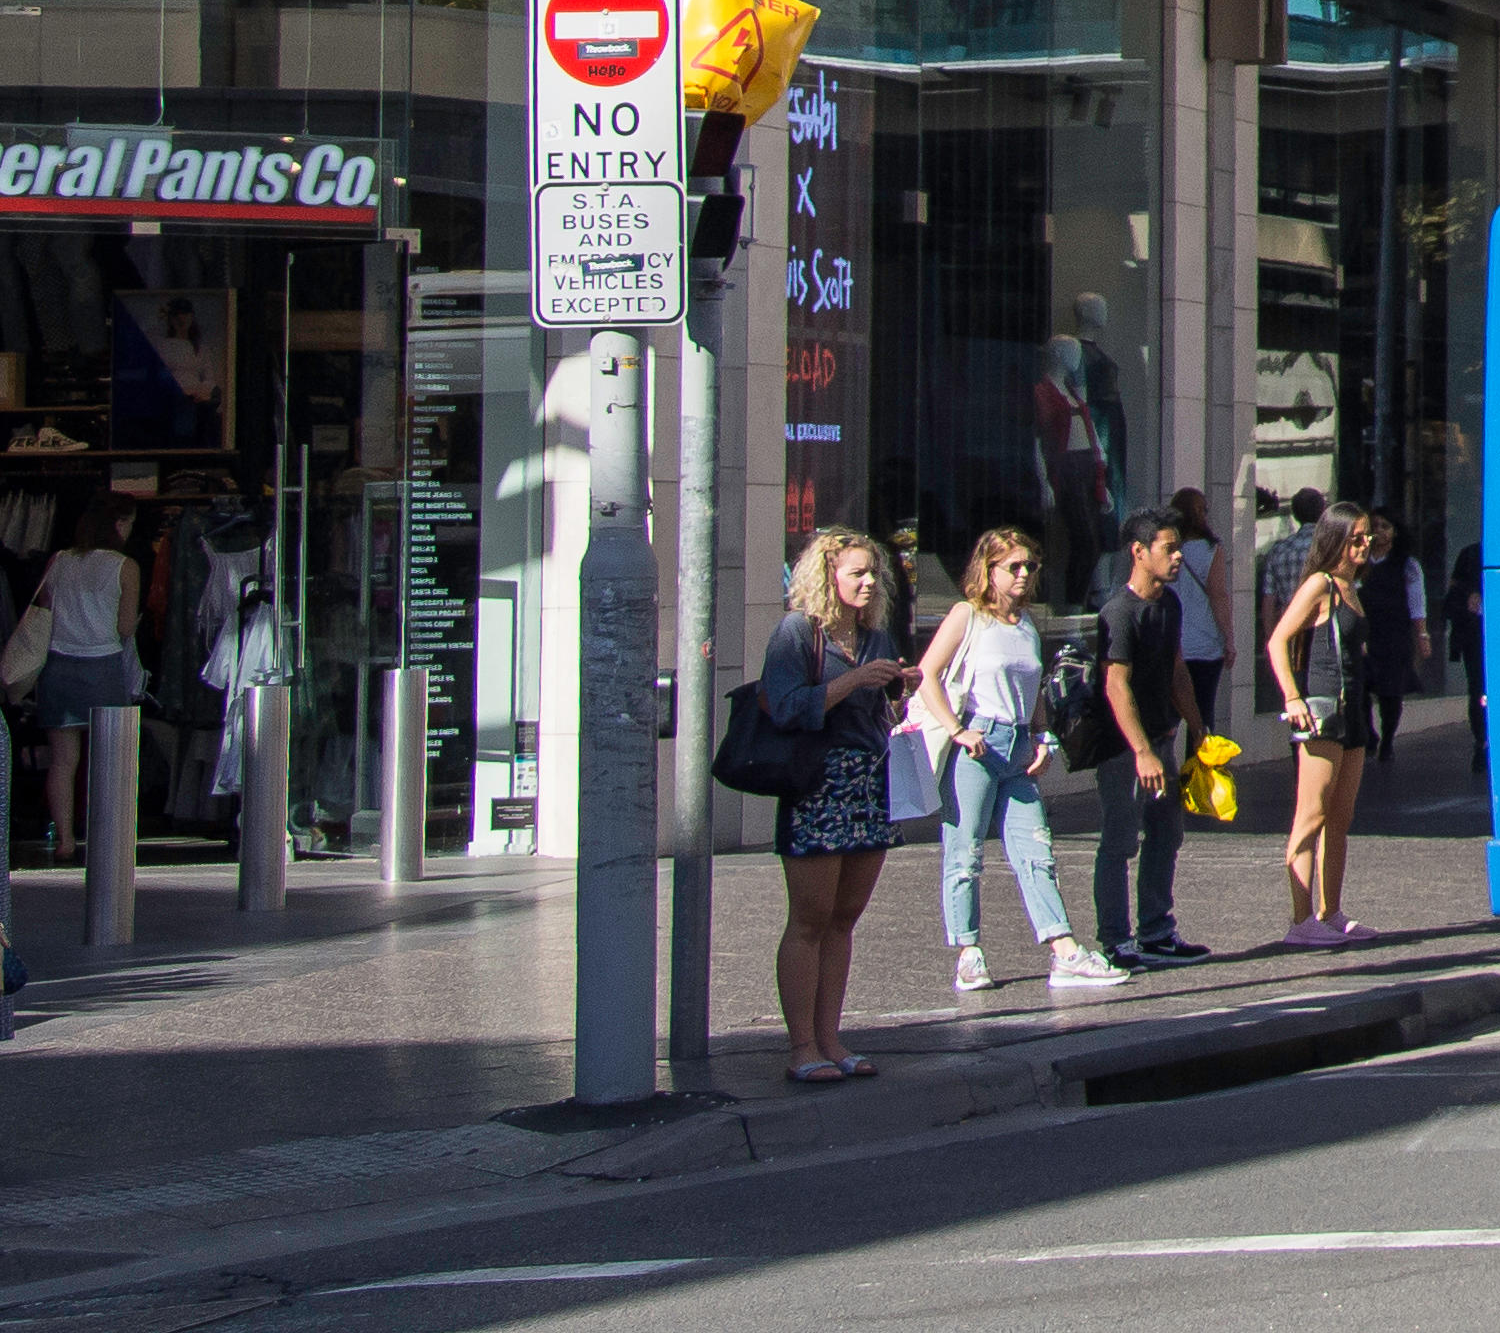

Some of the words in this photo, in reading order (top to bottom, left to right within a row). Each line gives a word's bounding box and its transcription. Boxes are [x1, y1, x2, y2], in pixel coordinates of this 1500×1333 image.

[573, 102, 640, 136] NO
[0, 138, 126, 197] eral
[121, 138, 293, 202] Pants
[295, 144, 380, 207] Co.
[547, 151, 666, 180] ENTRY
[572, 193, 641, 209] S.T.A.
[563, 214, 650, 230] BUSES
[579, 233, 632, 247] AND
[555, 273, 664, 290] VEHICLES
